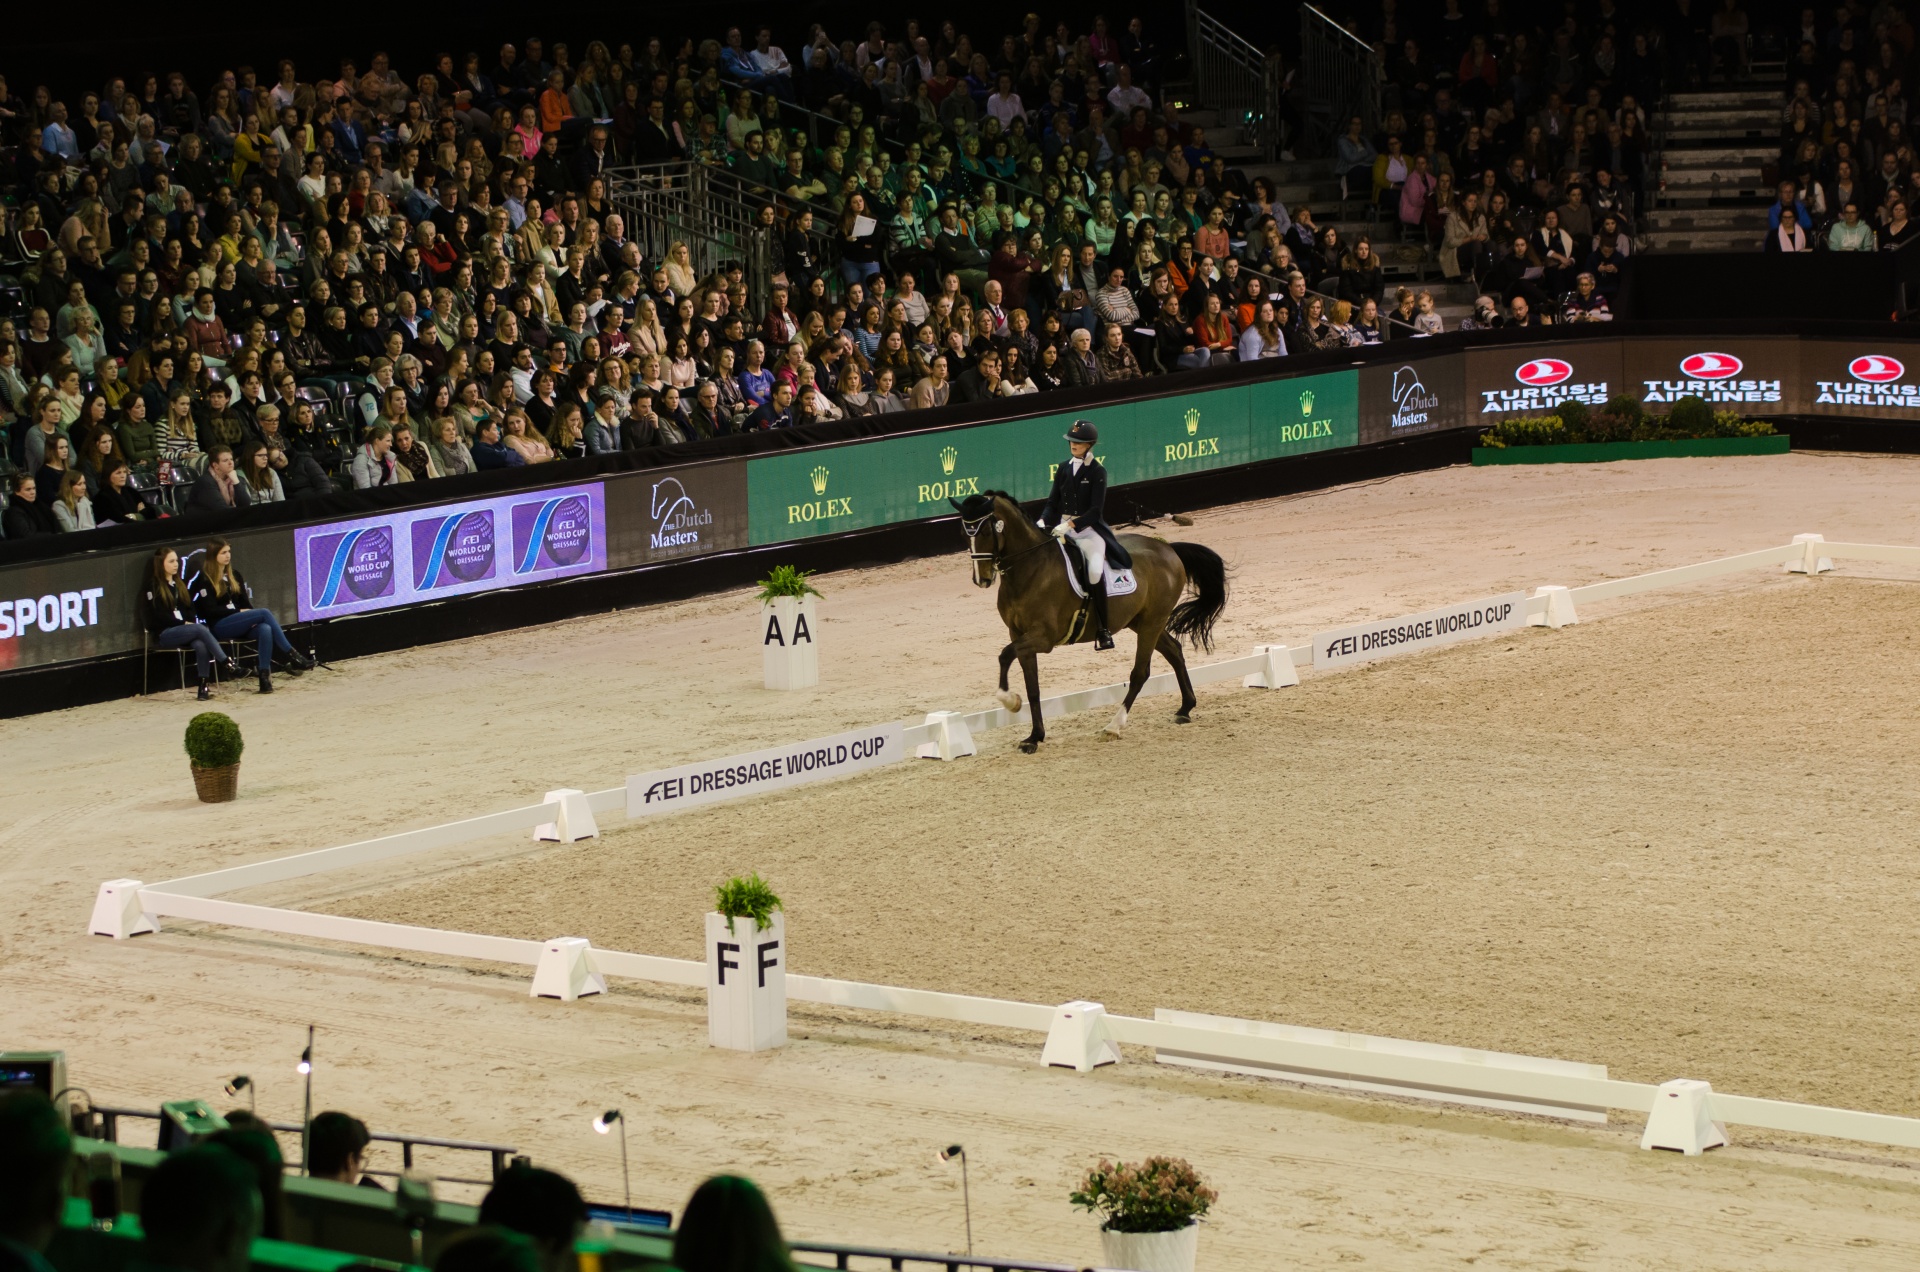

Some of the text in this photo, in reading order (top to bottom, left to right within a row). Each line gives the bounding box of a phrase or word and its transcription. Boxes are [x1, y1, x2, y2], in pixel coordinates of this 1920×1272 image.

[1482, 382, 1608, 401] TURKISH
[1643, 379, 1781, 392] TURKISH
[1816, 381, 1920, 396] TURKIS
[1410, 393, 1439, 411] Dutch
[1391, 412, 1428, 428] Masters
[1280, 418, 1333, 443] ROLEX
[1164, 436, 1219, 462] ROLEX
[918, 476, 980, 504] ROLEX
[674, 508, 713, 529] Dutch
[787, 496, 853, 524] ROLEX
[558, 519, 576, 530] FEI
[462, 534, 480, 546] FEI
[546, 528, 587, 542] WORLD CUP
[552, 539, 580, 550] DRESSAGE
[650, 530, 698, 549] Masters
[359, 551, 379, 563] FEI
[448, 544, 492, 558] WORLD CUP
[347, 560, 390, 574] WORLD CUP
[354, 571, 384, 582] DRESSAGE
[0, 587, 104, 640] SPORT
[764, 614, 786, 647] A
[792, 612, 812, 646] A
[1326, 636, 1357, 658] FEI
[1362, 620, 1433, 651] DRESSAGE
[1435, 609, 1483, 636] WORLD
[643, 777, 684, 804] FEI
[690, 757, 783, 795] DRESSAGE
[786, 744, 848, 775] WORLD
[717, 941, 740, 986] F
[757, 940, 779, 988] F
